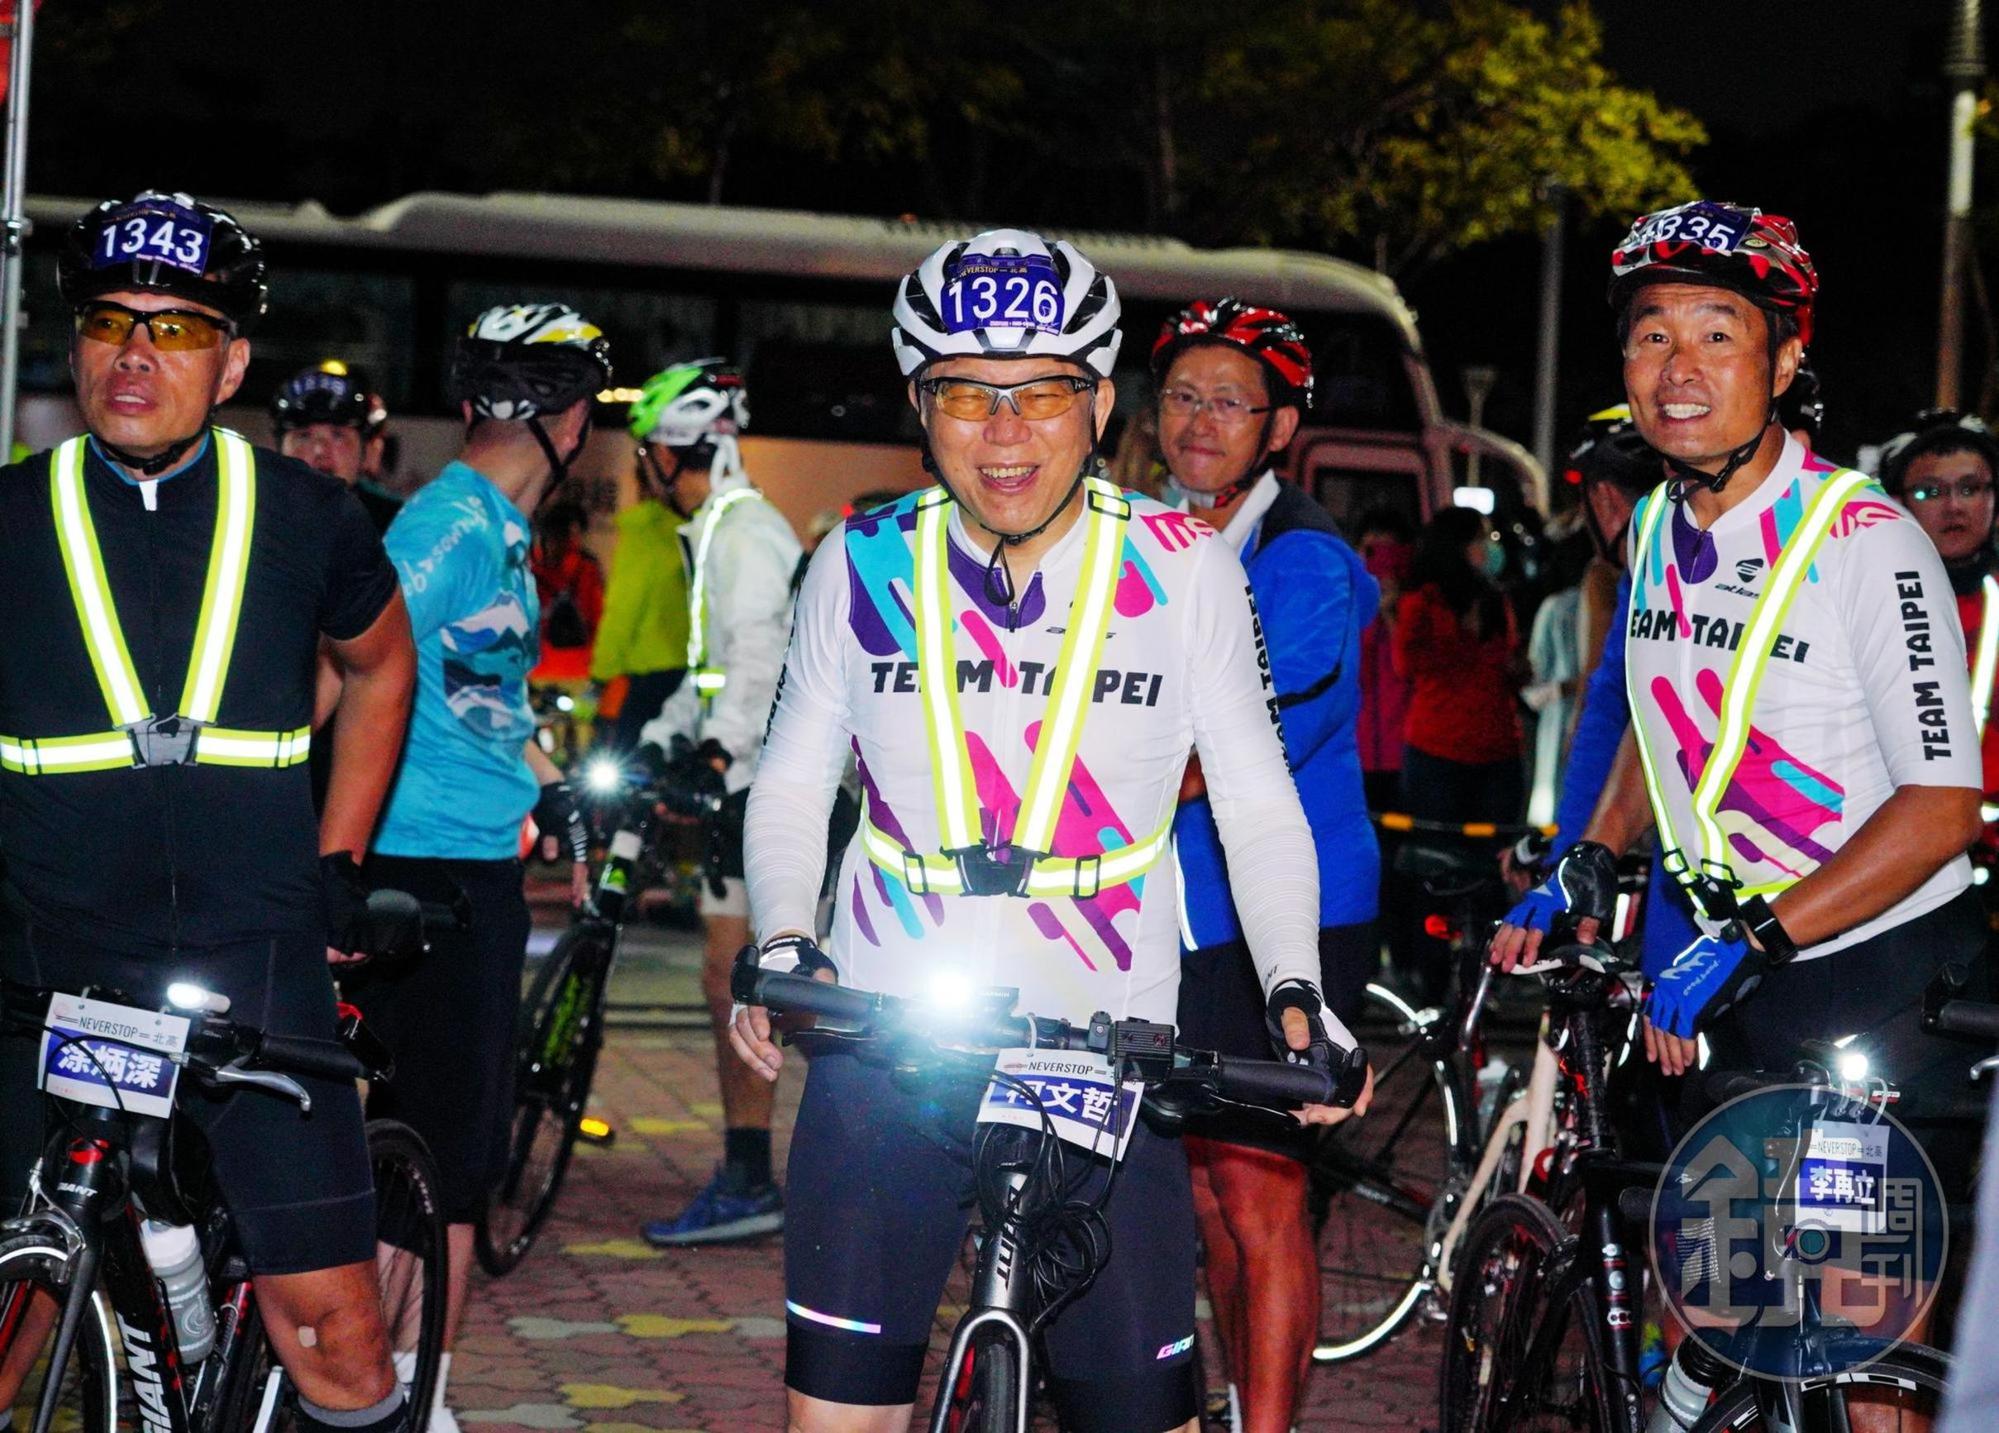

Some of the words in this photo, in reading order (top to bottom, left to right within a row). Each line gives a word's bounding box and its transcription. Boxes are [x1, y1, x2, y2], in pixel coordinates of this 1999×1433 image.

[103, 218, 203, 263] 1343
[949, 276, 1058, 323] 1326
[1630, 609, 1677, 642] EAM
[1692, 614, 1810, 664] TAIEI
[1895, 571, 1937, 672] TAIPEI
[871, 659, 995, 693] TEM
[1018, 661, 1164, 707] TPEI
[1913, 682, 1953, 761] TEAM
[80, 1016, 139, 1039] NEVERSTOP
[153, 1032, 179, 1048] 北高
[1029, 1061, 1094, 1076] NEVERSTOP
[1809, 1165, 1876, 1205] 李再立
